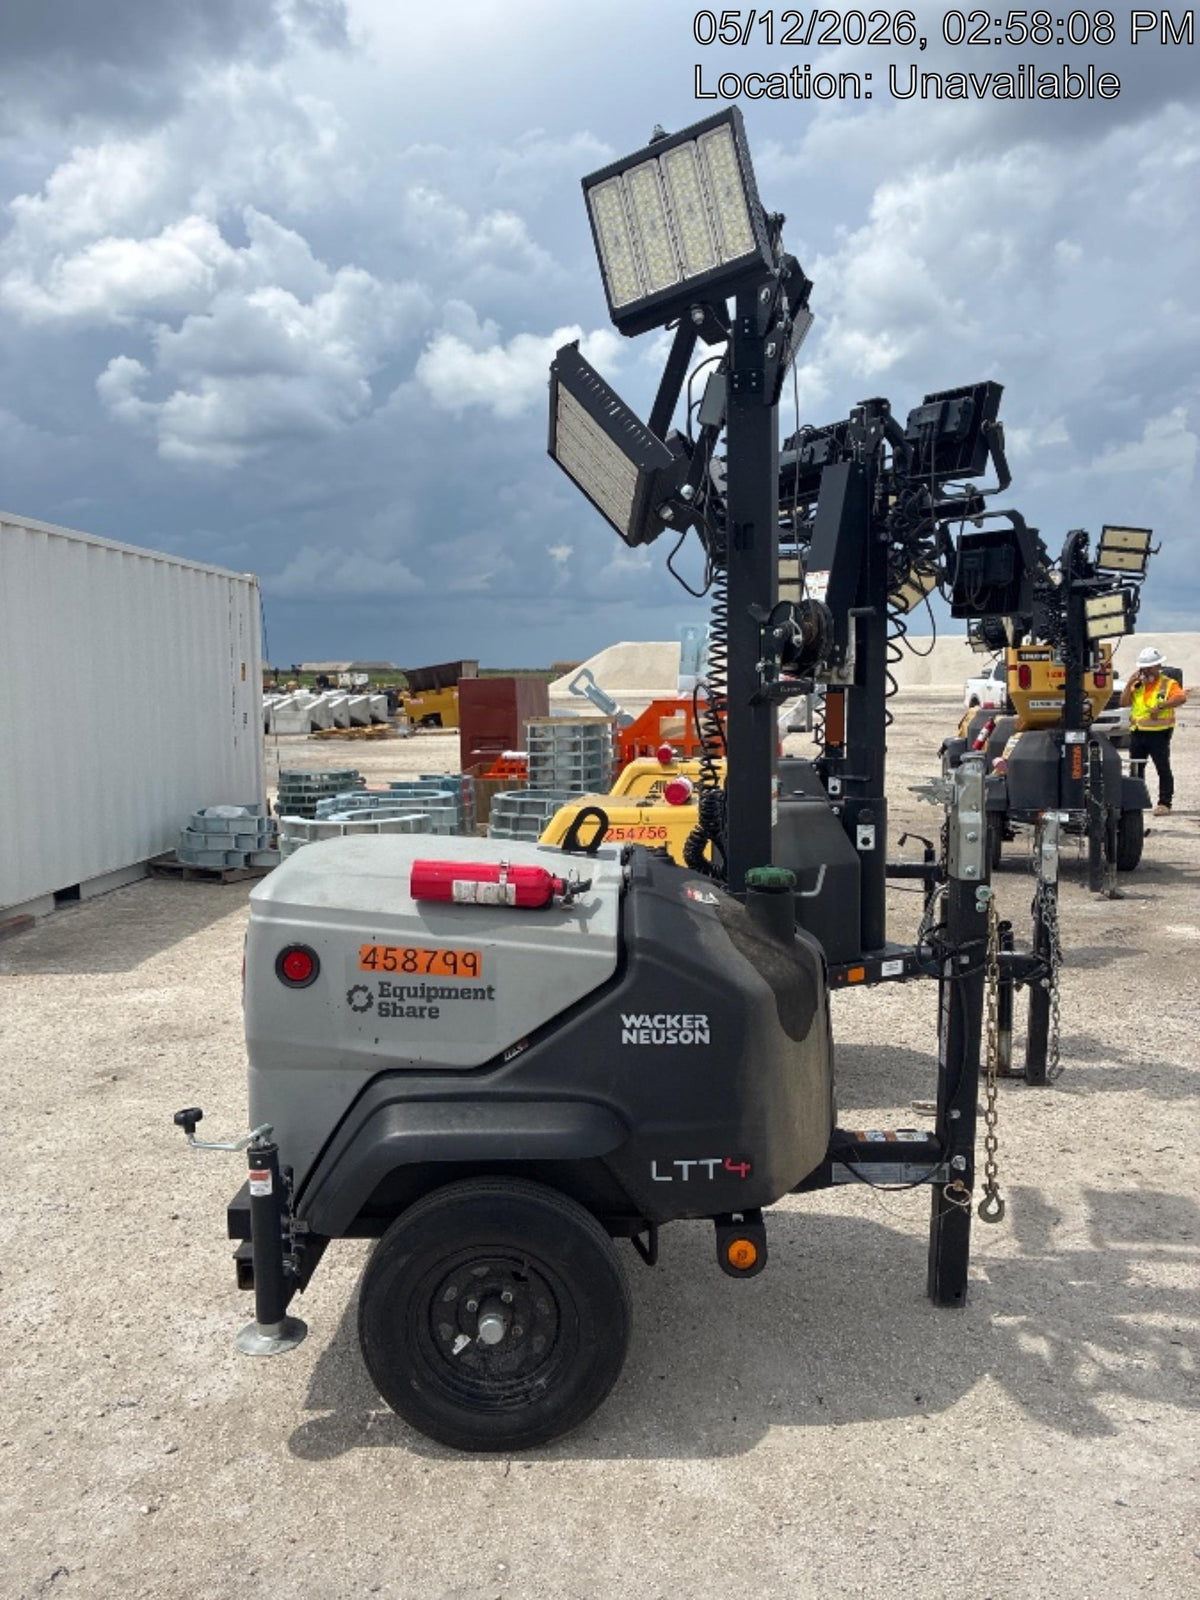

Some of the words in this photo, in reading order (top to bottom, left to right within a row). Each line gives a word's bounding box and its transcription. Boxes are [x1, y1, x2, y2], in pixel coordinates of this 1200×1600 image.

[362, 947, 478, 976] 458799
[378, 981, 496, 1003] Equipment
[378, 1001, 440, 1019] Share
[620, 1014, 709, 1029] WACKER
[622, 1029, 710, 1045] NEUSON
[651, 1158, 751, 1181] LTT4
